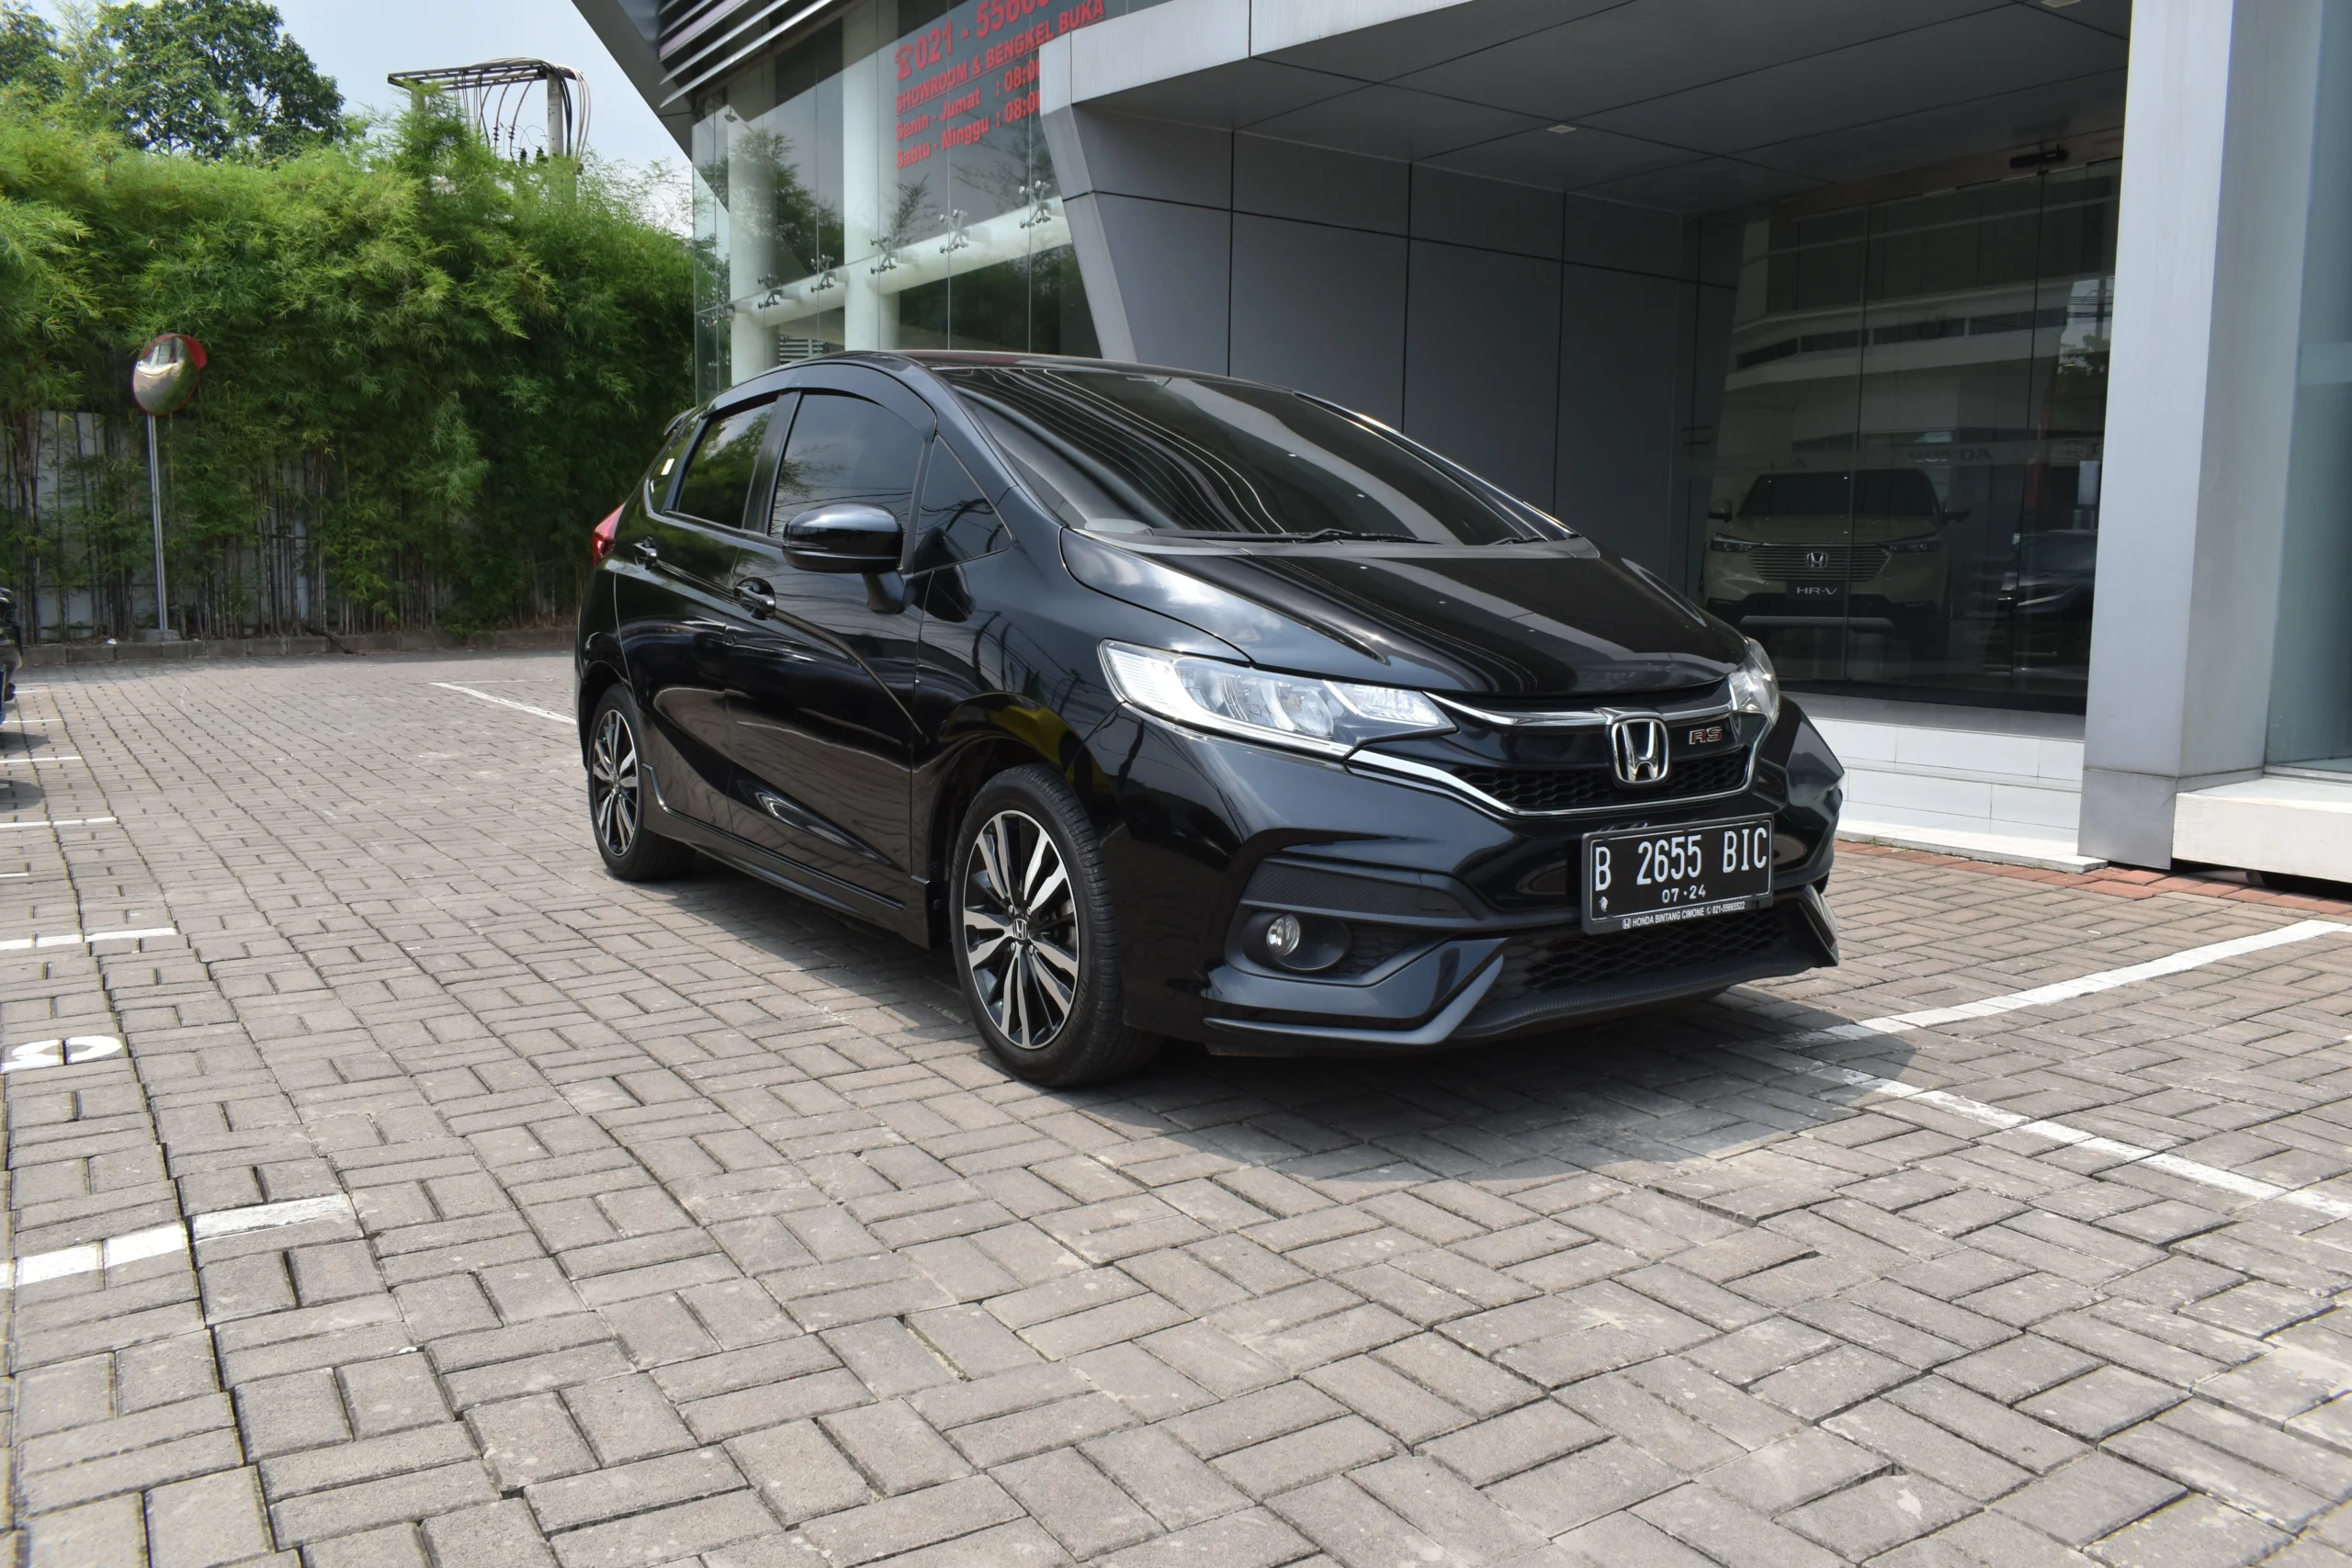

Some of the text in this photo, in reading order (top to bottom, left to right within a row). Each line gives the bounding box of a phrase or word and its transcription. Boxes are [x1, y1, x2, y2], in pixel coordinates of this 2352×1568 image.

[896, 0, 1104, 113] SHOWROOM & BENGKEL BUKA
[916, 18, 953, 70] 021
[896, 113, 930, 141] Senin
[940, 86, 981, 122] Jumat
[896, 142, 932, 169] Sabtu
[942, 117, 990, 151] Minggu
[1796, 586, 1838, 595] HR-V
[1689, 727, 1722, 745] RS
[1595, 827, 1768, 892] B 2655 BIC
[1632, 914, 1654, 928] HONDA
[1655, 909, 1681, 924] BINTANG
[1681, 906, 1705, 919] CIMONE
